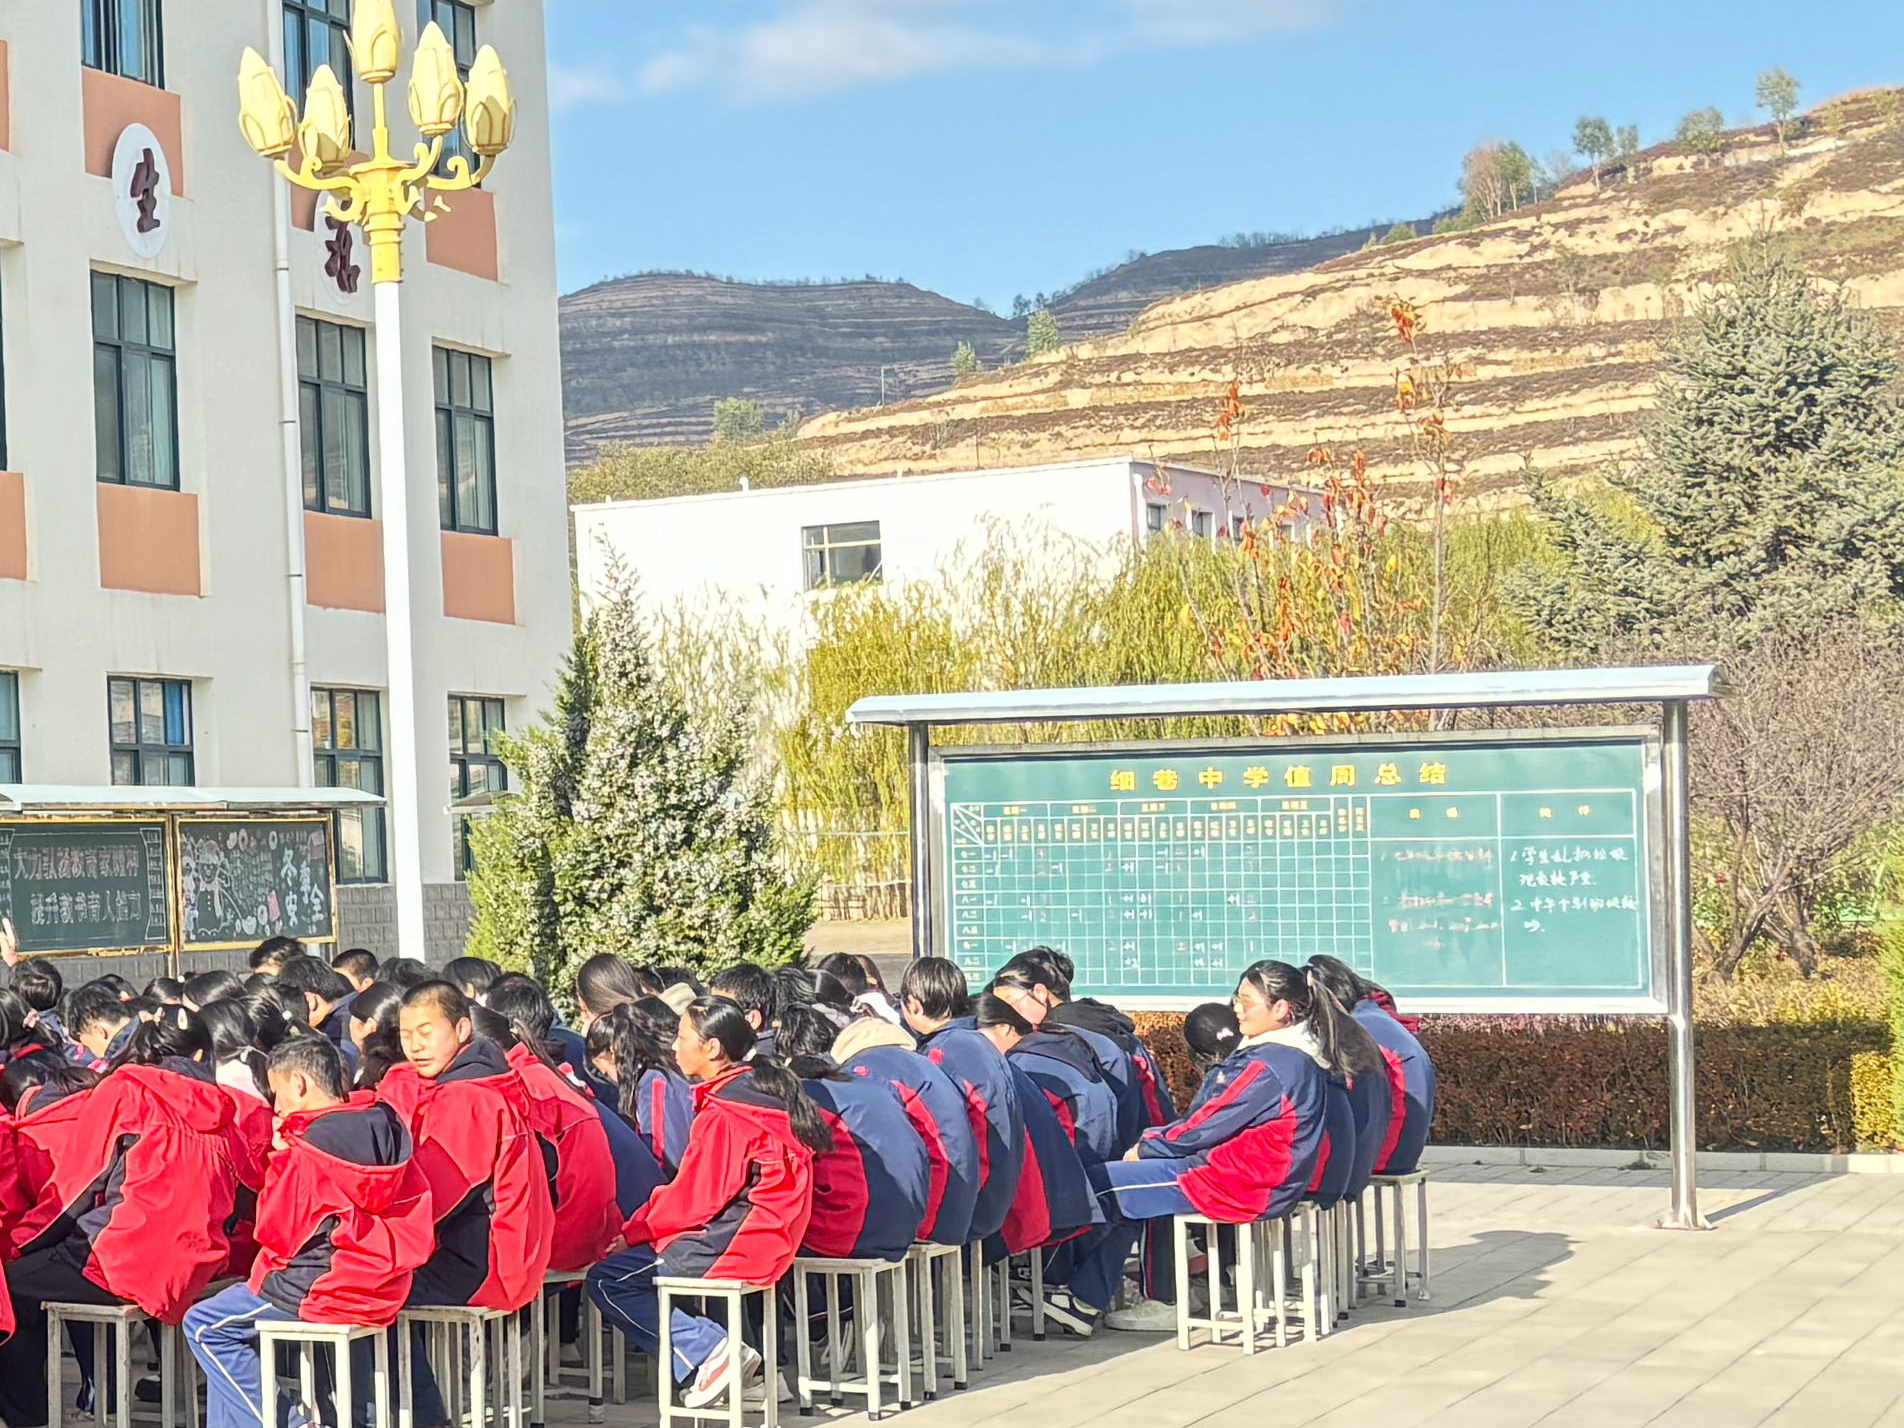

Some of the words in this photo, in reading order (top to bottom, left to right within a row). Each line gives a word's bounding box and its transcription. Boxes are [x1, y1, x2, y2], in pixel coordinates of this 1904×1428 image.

[1108, 761, 1450, 793] 细巷中学值周总结
